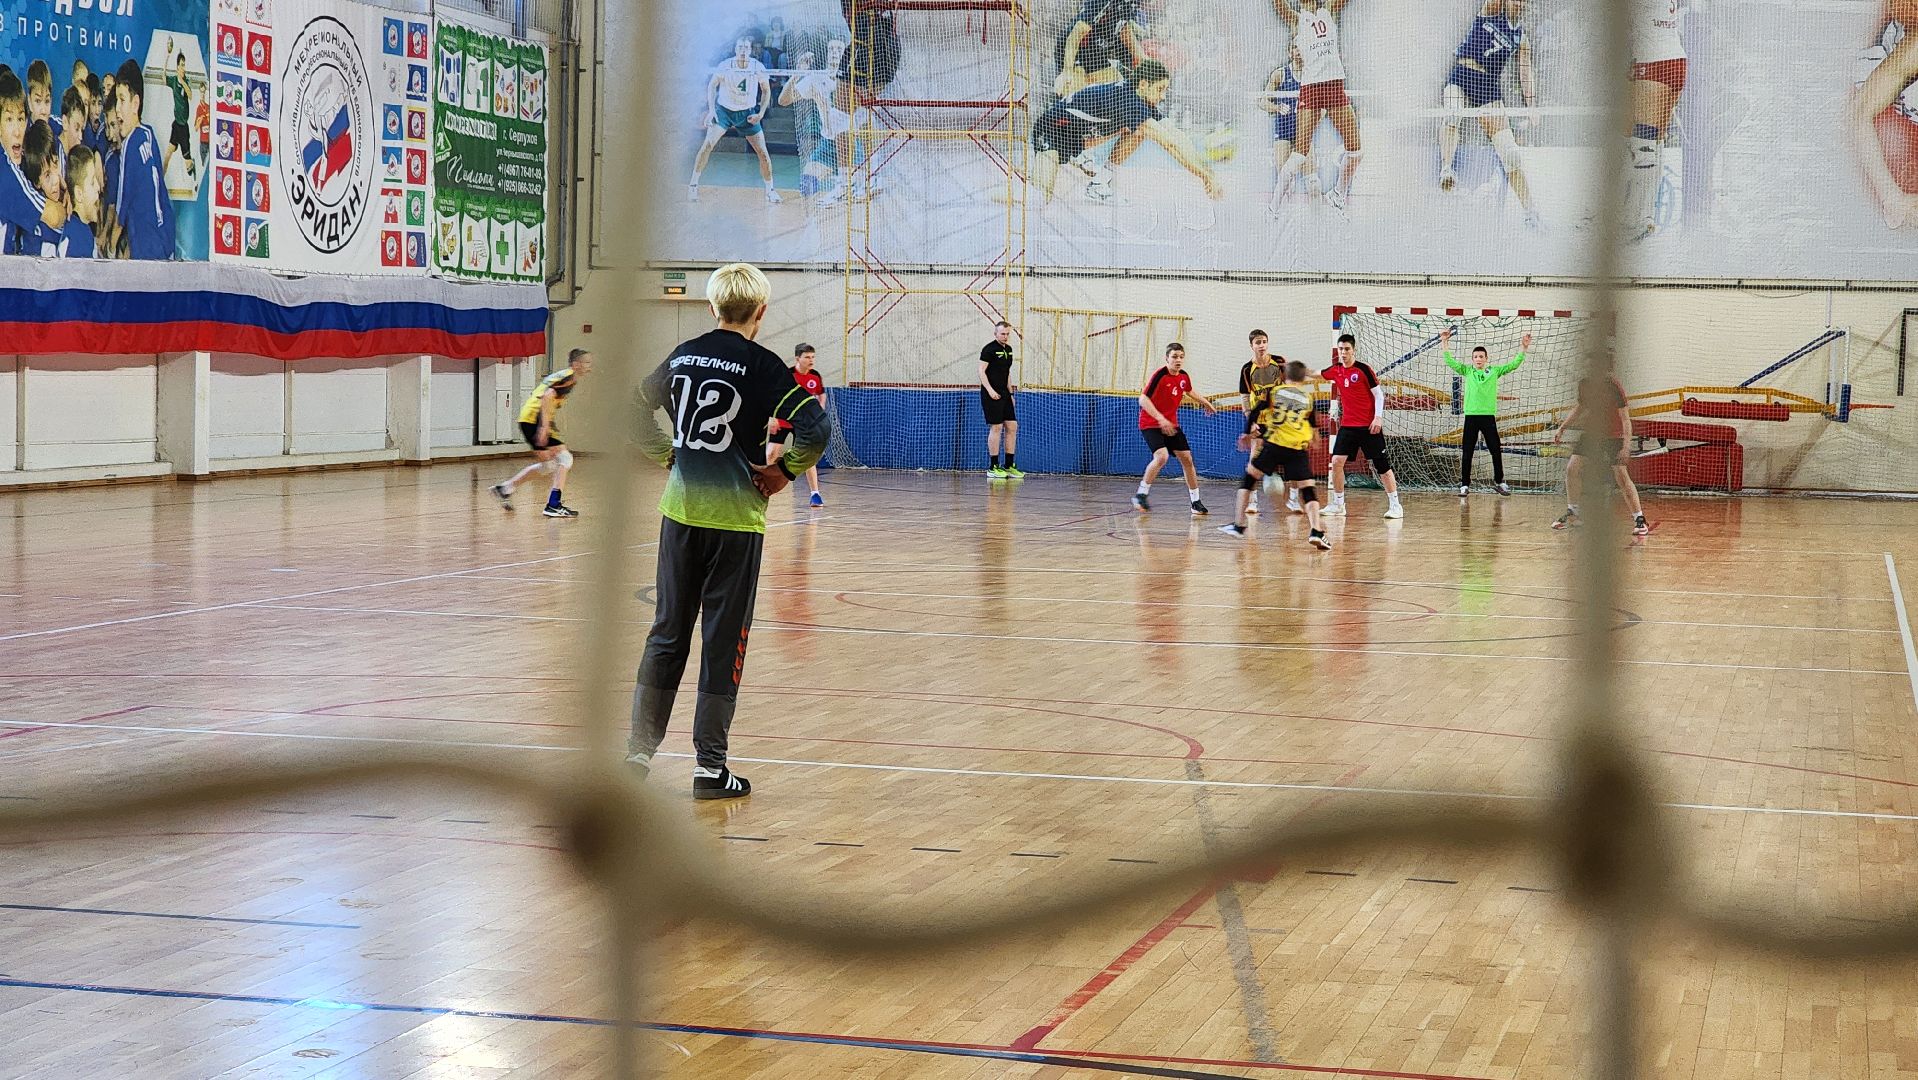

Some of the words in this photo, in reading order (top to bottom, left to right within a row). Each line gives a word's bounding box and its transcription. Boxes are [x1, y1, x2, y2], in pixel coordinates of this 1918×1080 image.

[18, 17, 132, 53] ПРОТВИНО
[1311, 20, 1327, 35] 10
[737, 79, 747, 92] 4
[509, 128, 538, 147] Серпухов
[291, 174, 361, 249] ЭРИДАН
[670, 375, 742, 452] 12
